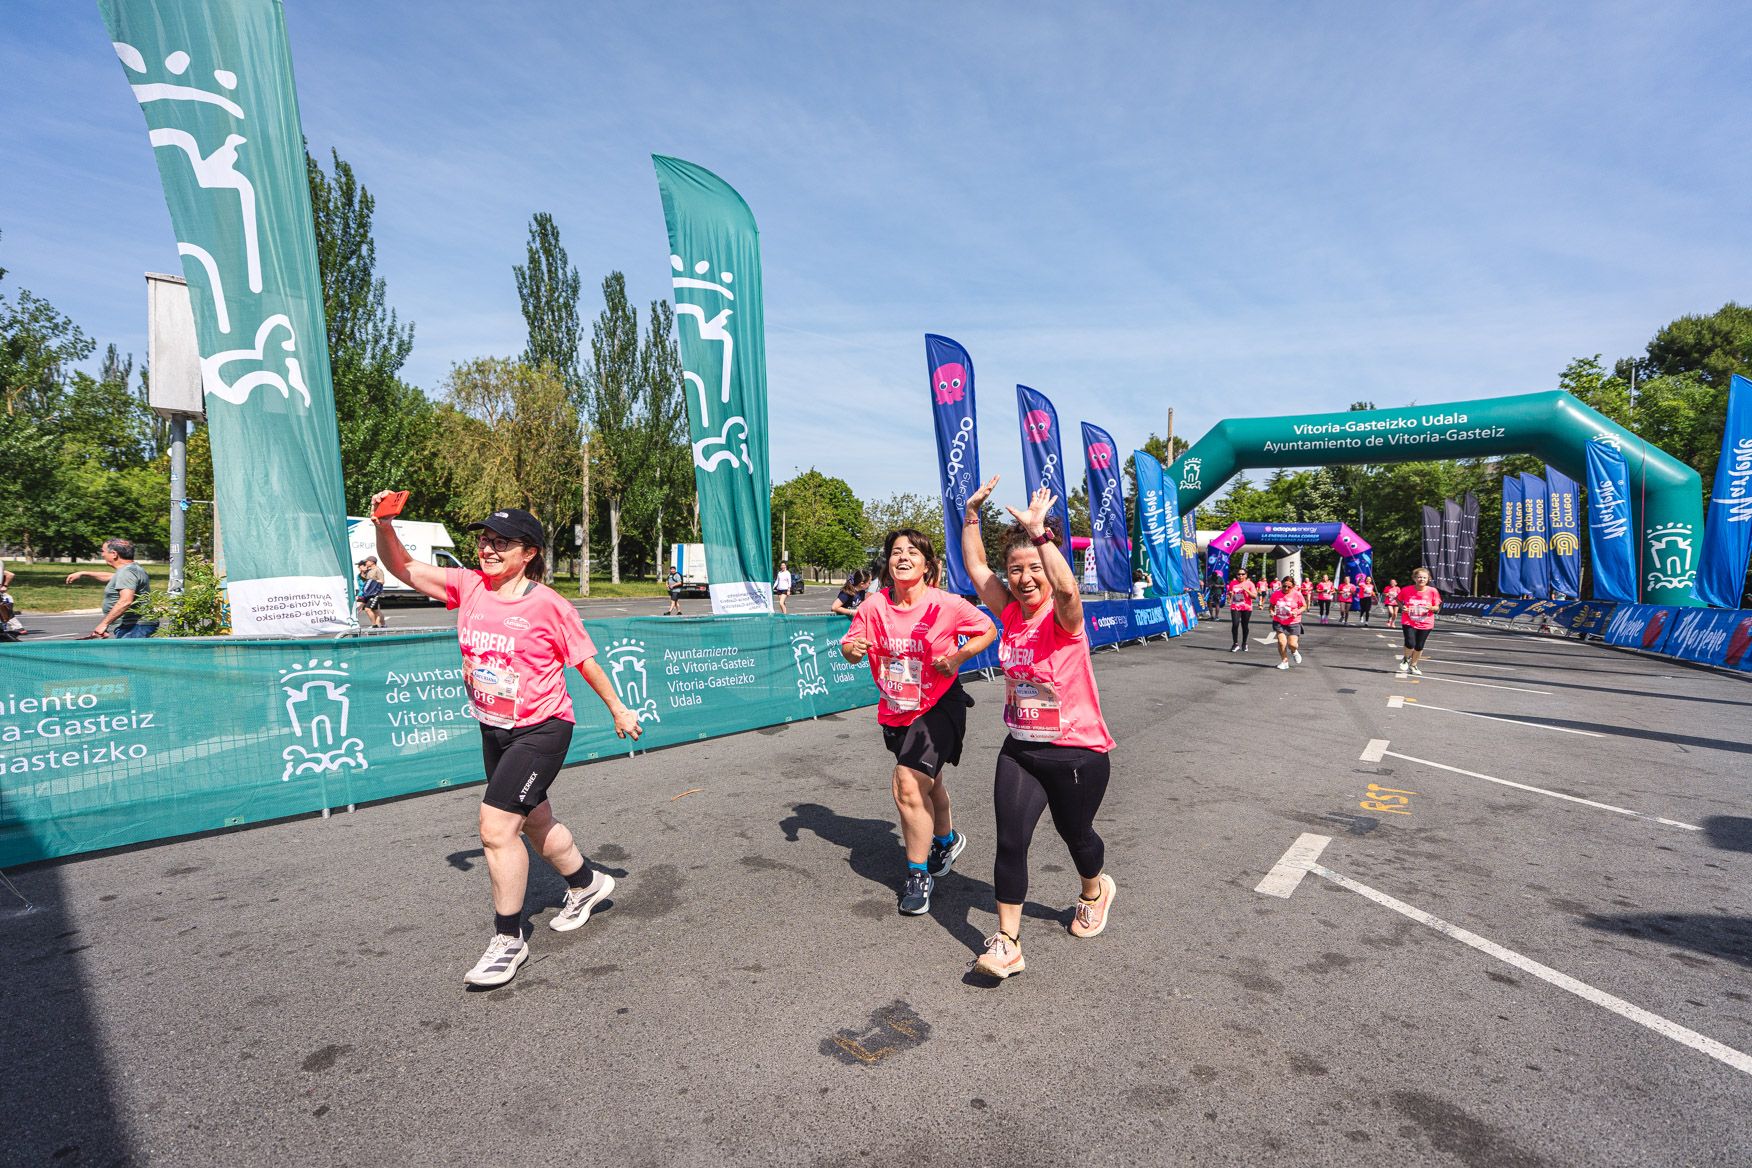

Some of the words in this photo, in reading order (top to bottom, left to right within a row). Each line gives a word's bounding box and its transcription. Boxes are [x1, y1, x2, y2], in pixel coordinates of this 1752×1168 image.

[1293, 418, 1418, 436] Vitoria-Gasteizko
[1422, 412, 1468, 427] Udala
[1263, 436, 1361, 453] Ayuntamiento
[1365, 434, 1384, 447] de
[1388, 425, 1506, 446] Vitoria-Gasteiz
[351, 541, 375, 549] GRUP
[460, 627, 516, 655] CARRERA
[1672, 610, 1727, 659] Marlene
[664, 645, 739, 663] Ayuntamiento
[827, 648, 838, 658] de
[665, 662, 680, 676] de
[682, 656, 756, 674] Vitoria-Gasteiz
[667, 672, 755, 693] Vitoria-Gasteizko
[833, 672, 855, 683] Udala
[887, 680, 903, 691] 016
[386, 687, 411, 704] de
[474, 689, 495, 705] 016
[670, 693, 702, 708] Udala
[1017, 708, 1040, 719] 016
[391, 726, 448, 747] Udala
[521, 771, 538, 794] TERREX
